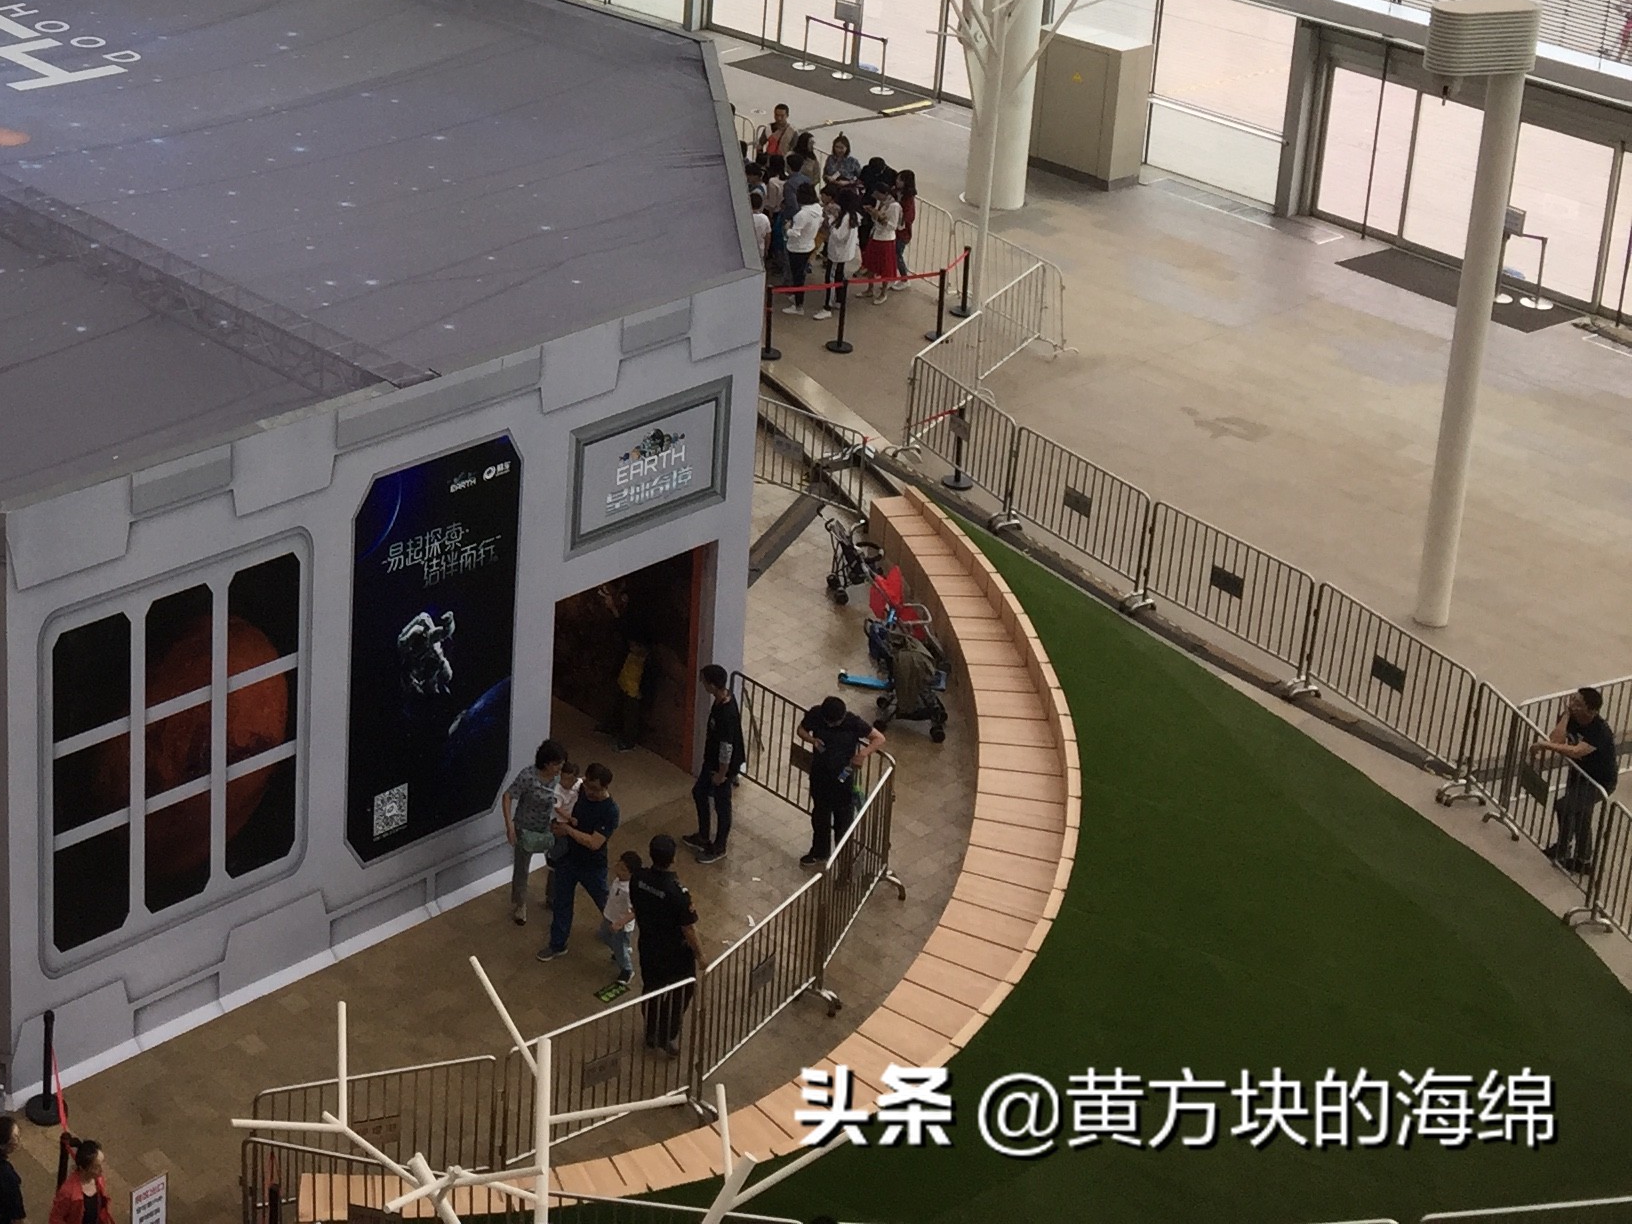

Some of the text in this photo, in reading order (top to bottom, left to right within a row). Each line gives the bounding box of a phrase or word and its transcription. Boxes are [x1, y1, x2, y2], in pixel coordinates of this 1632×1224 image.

[616, 445, 686, 486] EARTH
[386, 522, 464, 574] 易起探索
[423, 536, 498, 589] 结伴而行
